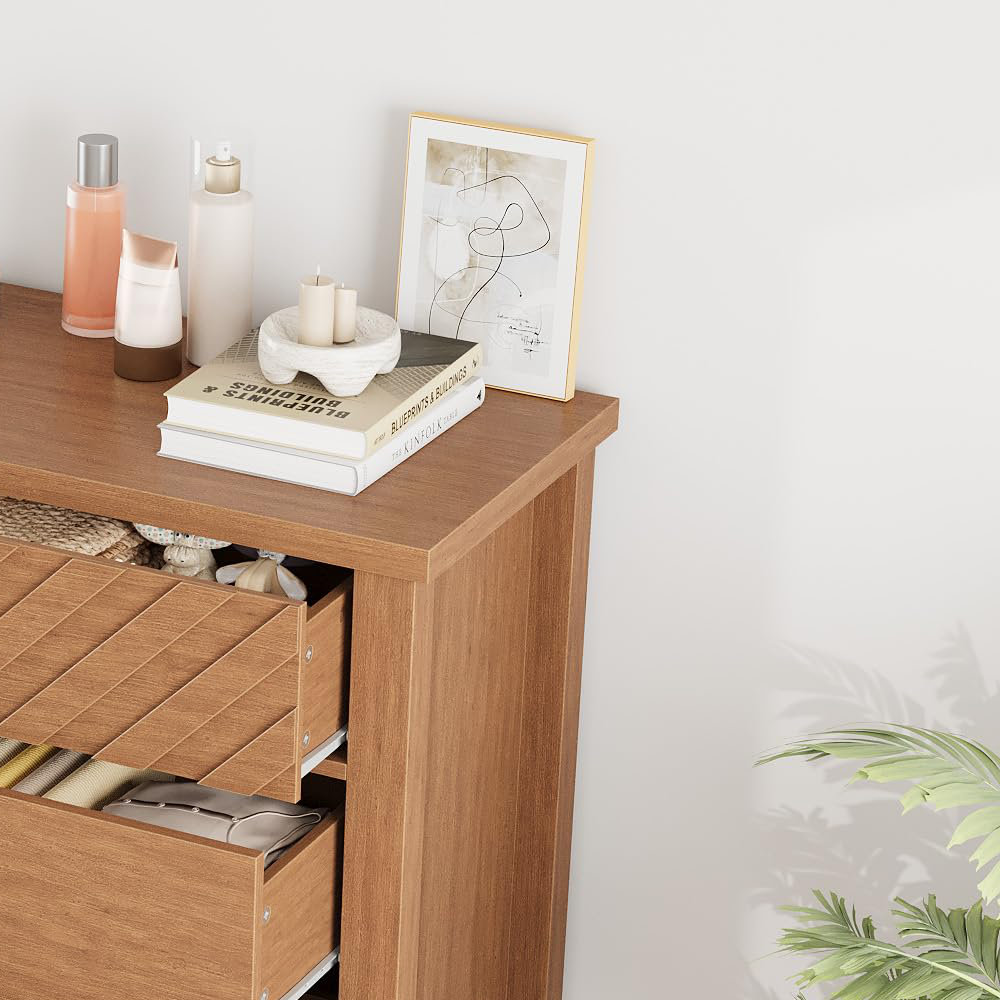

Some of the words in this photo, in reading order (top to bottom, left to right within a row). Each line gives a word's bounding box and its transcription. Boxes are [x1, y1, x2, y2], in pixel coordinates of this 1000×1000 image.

[202, 385, 219, 393] &
[222, 389, 351, 419] BLUEPRINTS
[229, 381, 342, 408] BUILDINGS
[391, 396, 429, 435] BLUEPRINTS
[429, 391, 435, 404] &
[435, 366, 467, 400] BUILDINGS
[403, 419, 442, 455] KINFOLK
